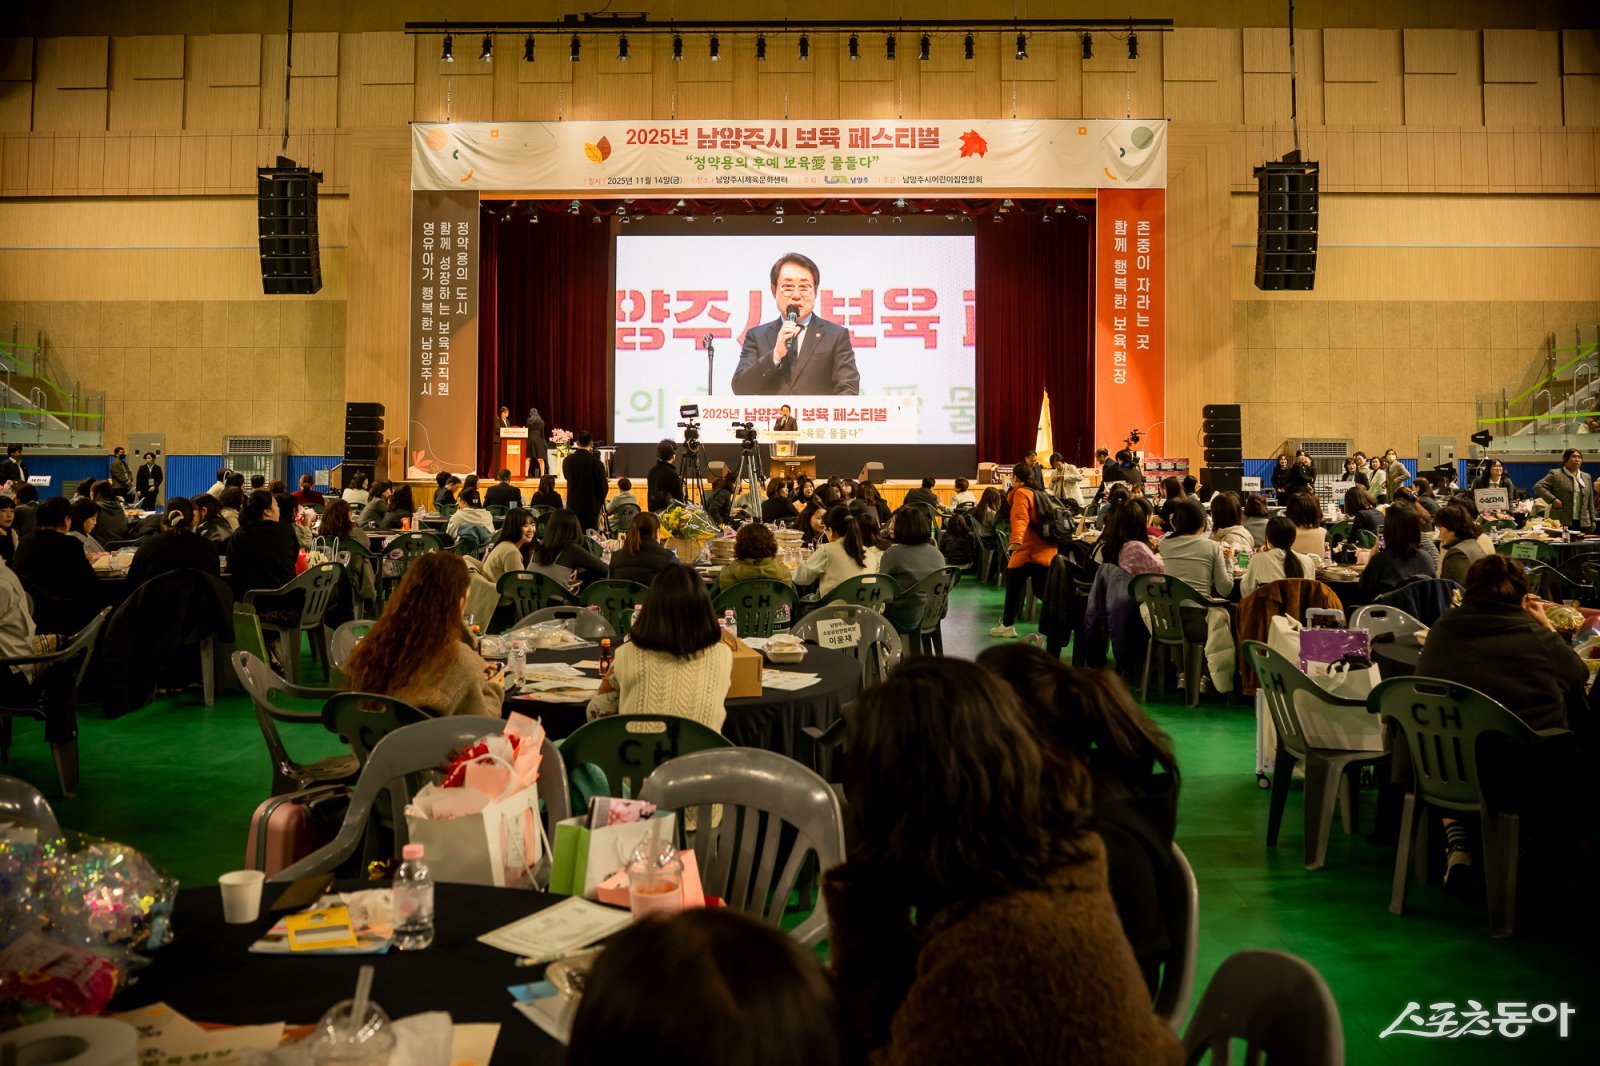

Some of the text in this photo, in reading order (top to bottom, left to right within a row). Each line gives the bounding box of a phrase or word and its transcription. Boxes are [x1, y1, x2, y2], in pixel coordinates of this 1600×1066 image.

[625, 126, 940, 150] 2025년 남양주시 보육 페스티벌
[752, 156, 781, 170] 후예
[783, 156, 826, 171] 보육愛
[607, 177, 633, 186] 2025년
[635, 176, 652, 185] 11월
[654, 176, 683, 185] 14일(금)
[715, 175, 789, 185] 남양주시체육문화센터
[902, 175, 983, 185] 남양주시어린이집연합회
[455, 222, 469, 315] 정약용의 도시
[1136, 221, 1150, 350] 존중이 자라는 곳
[420, 222, 434, 396] 영유아가 행복한 남양주시
[437, 222, 451, 396] 함께 성장하는 보육교직원
[1113, 220, 1128, 385] 함께 행복한 보육현장
[702, 407, 888, 422] 2025년 남양주 보육 페스티벌
[1479, 496, 1505, 504] 수상자석
[313, 575, 333, 588] CH
[517, 587, 541, 600] CH
[856, 586, 881, 601] CH
[742, 595, 770, 608] CH
[1411, 703, 1462, 730] CH
